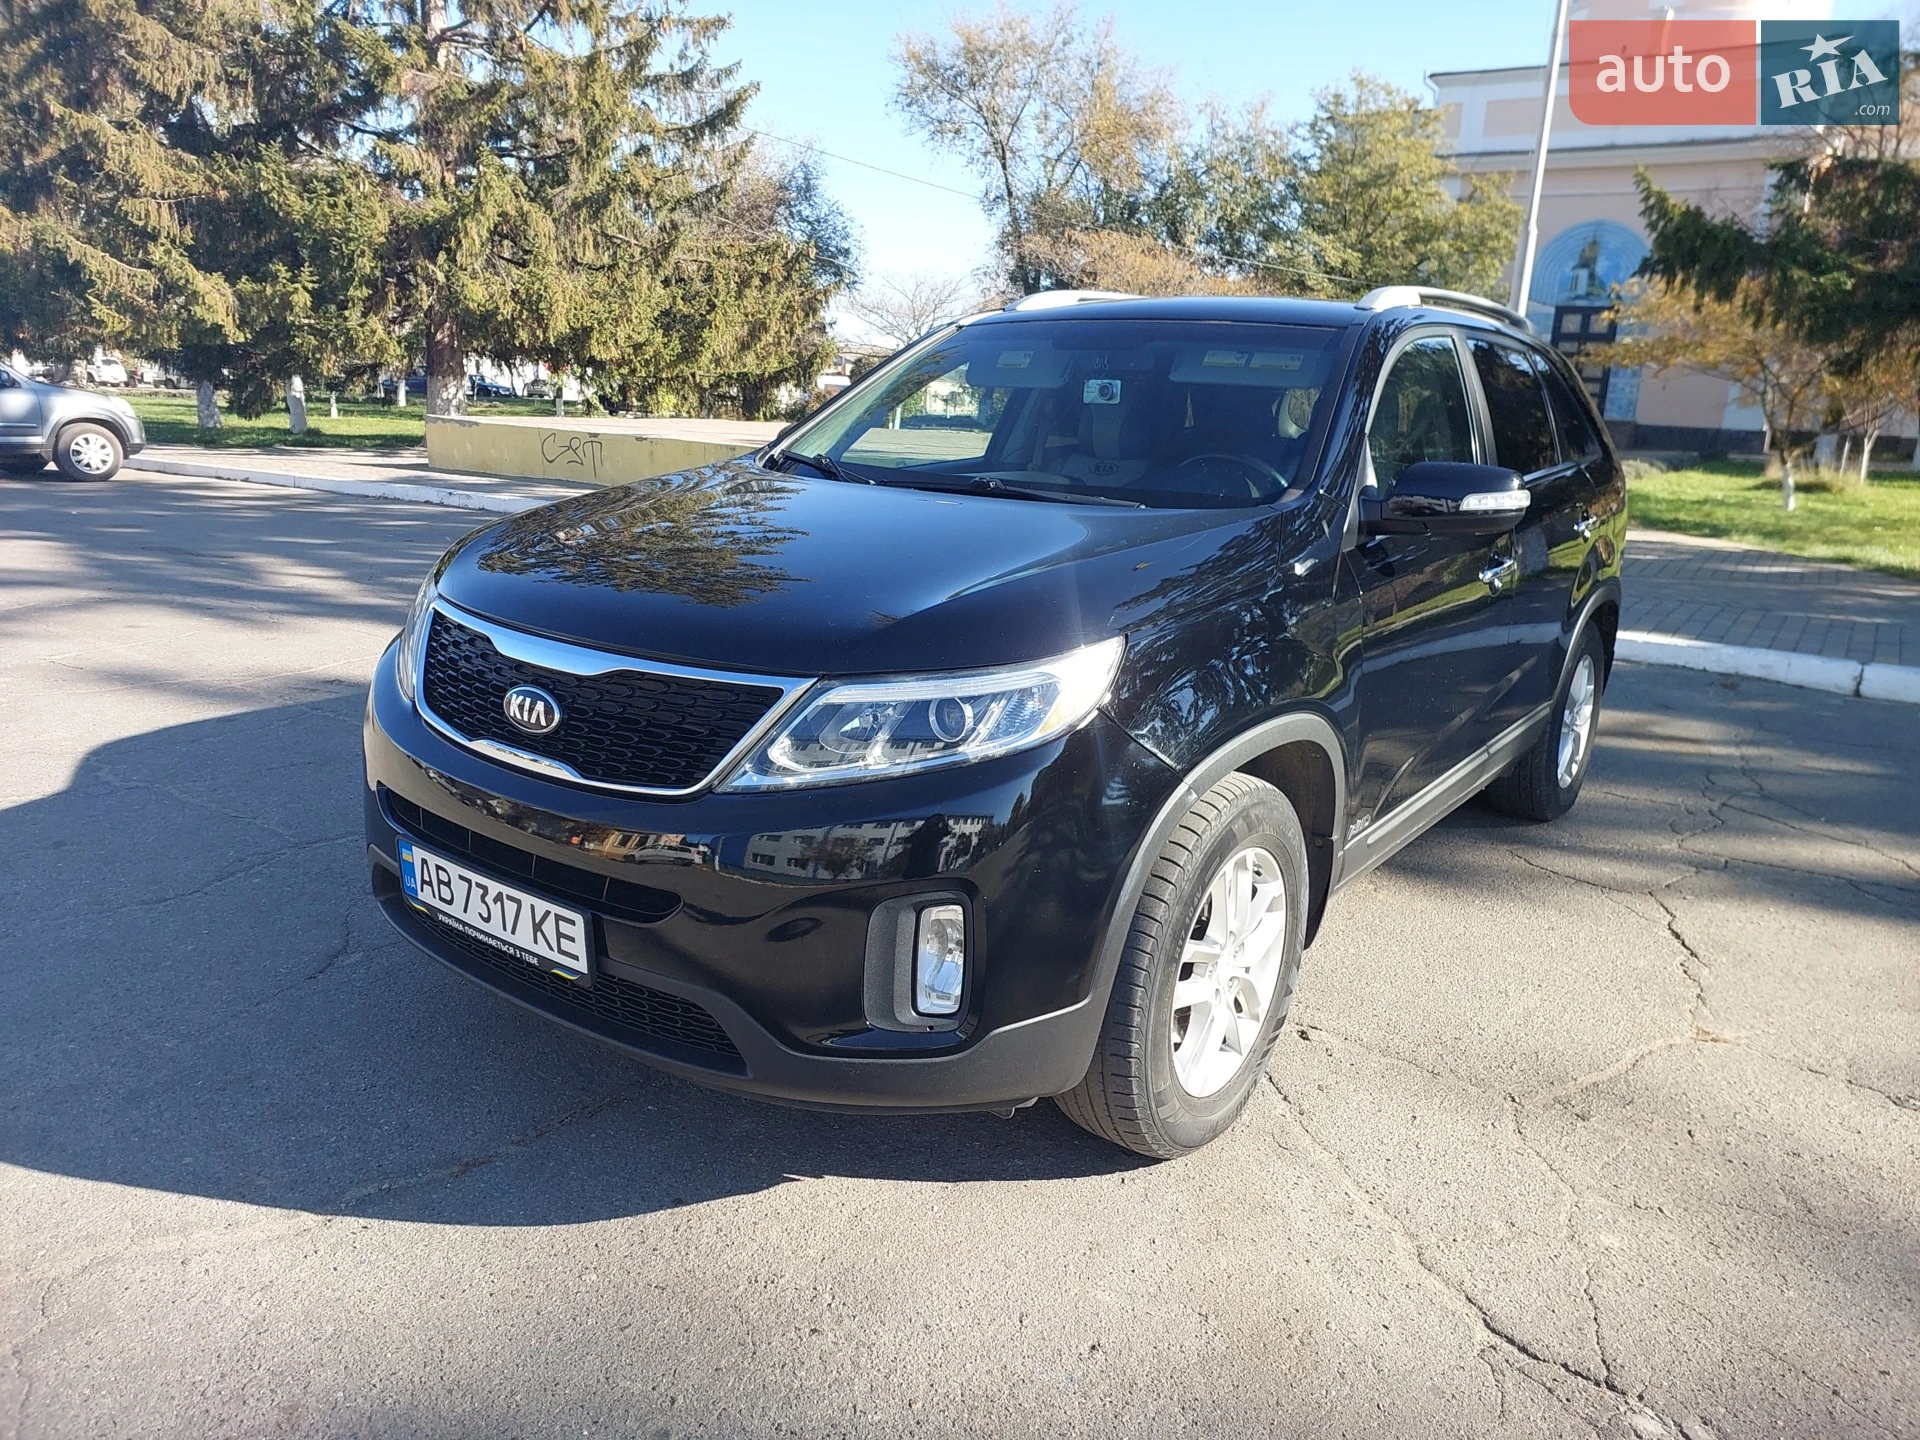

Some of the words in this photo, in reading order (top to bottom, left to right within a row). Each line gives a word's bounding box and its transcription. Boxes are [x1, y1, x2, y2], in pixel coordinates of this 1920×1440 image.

[509, 693, 547, 727] KIA
[404, 874, 416, 890] UA
[436, 912, 465, 933] УКРАЇНА
[464, 926, 515, 956] ПОЧИНАЄТЬСЯ
[520, 951, 540, 966] ТЕБЕ
